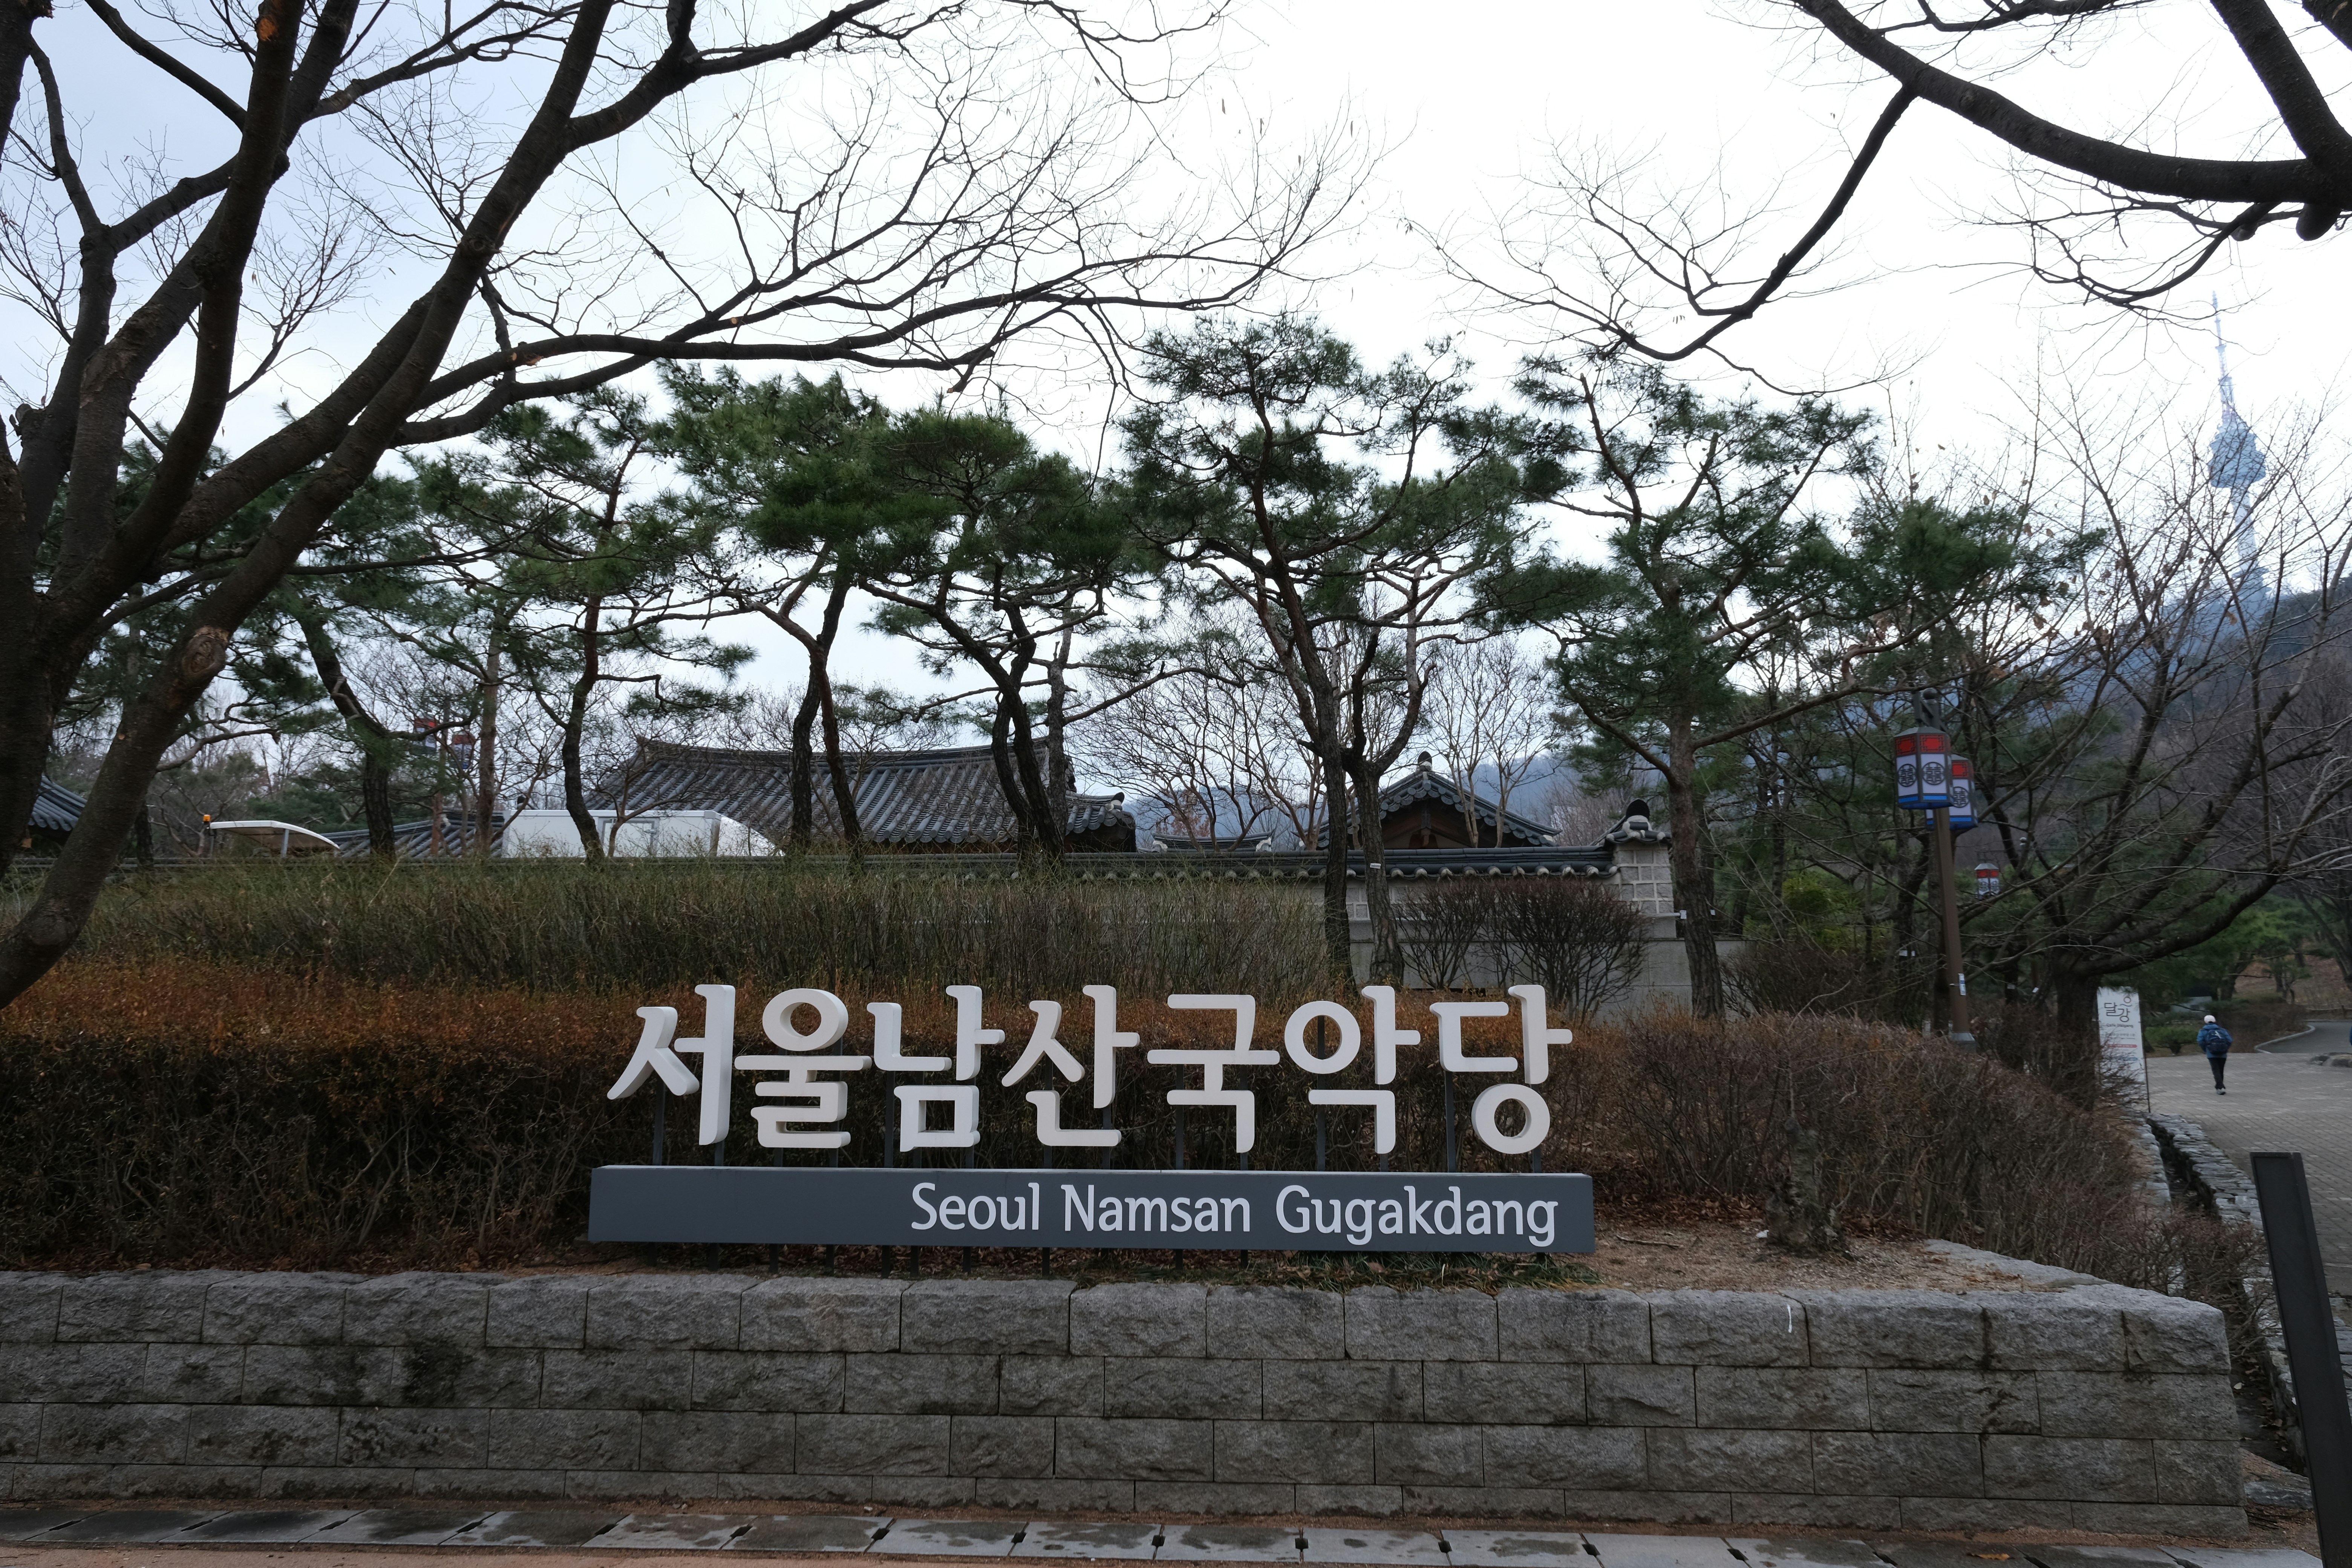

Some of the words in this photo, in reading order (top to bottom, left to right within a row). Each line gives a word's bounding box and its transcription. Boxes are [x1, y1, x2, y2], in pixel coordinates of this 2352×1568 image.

[2104, 1002, 2130, 1022] 달강
[606, 984, 1573, 1155] 서울남산국악당
[911, 1182, 1040, 1232] Seoul
[1060, 1184, 1251, 1234] Namsan
[1276, 1184, 1559, 1247] Gugakdang
